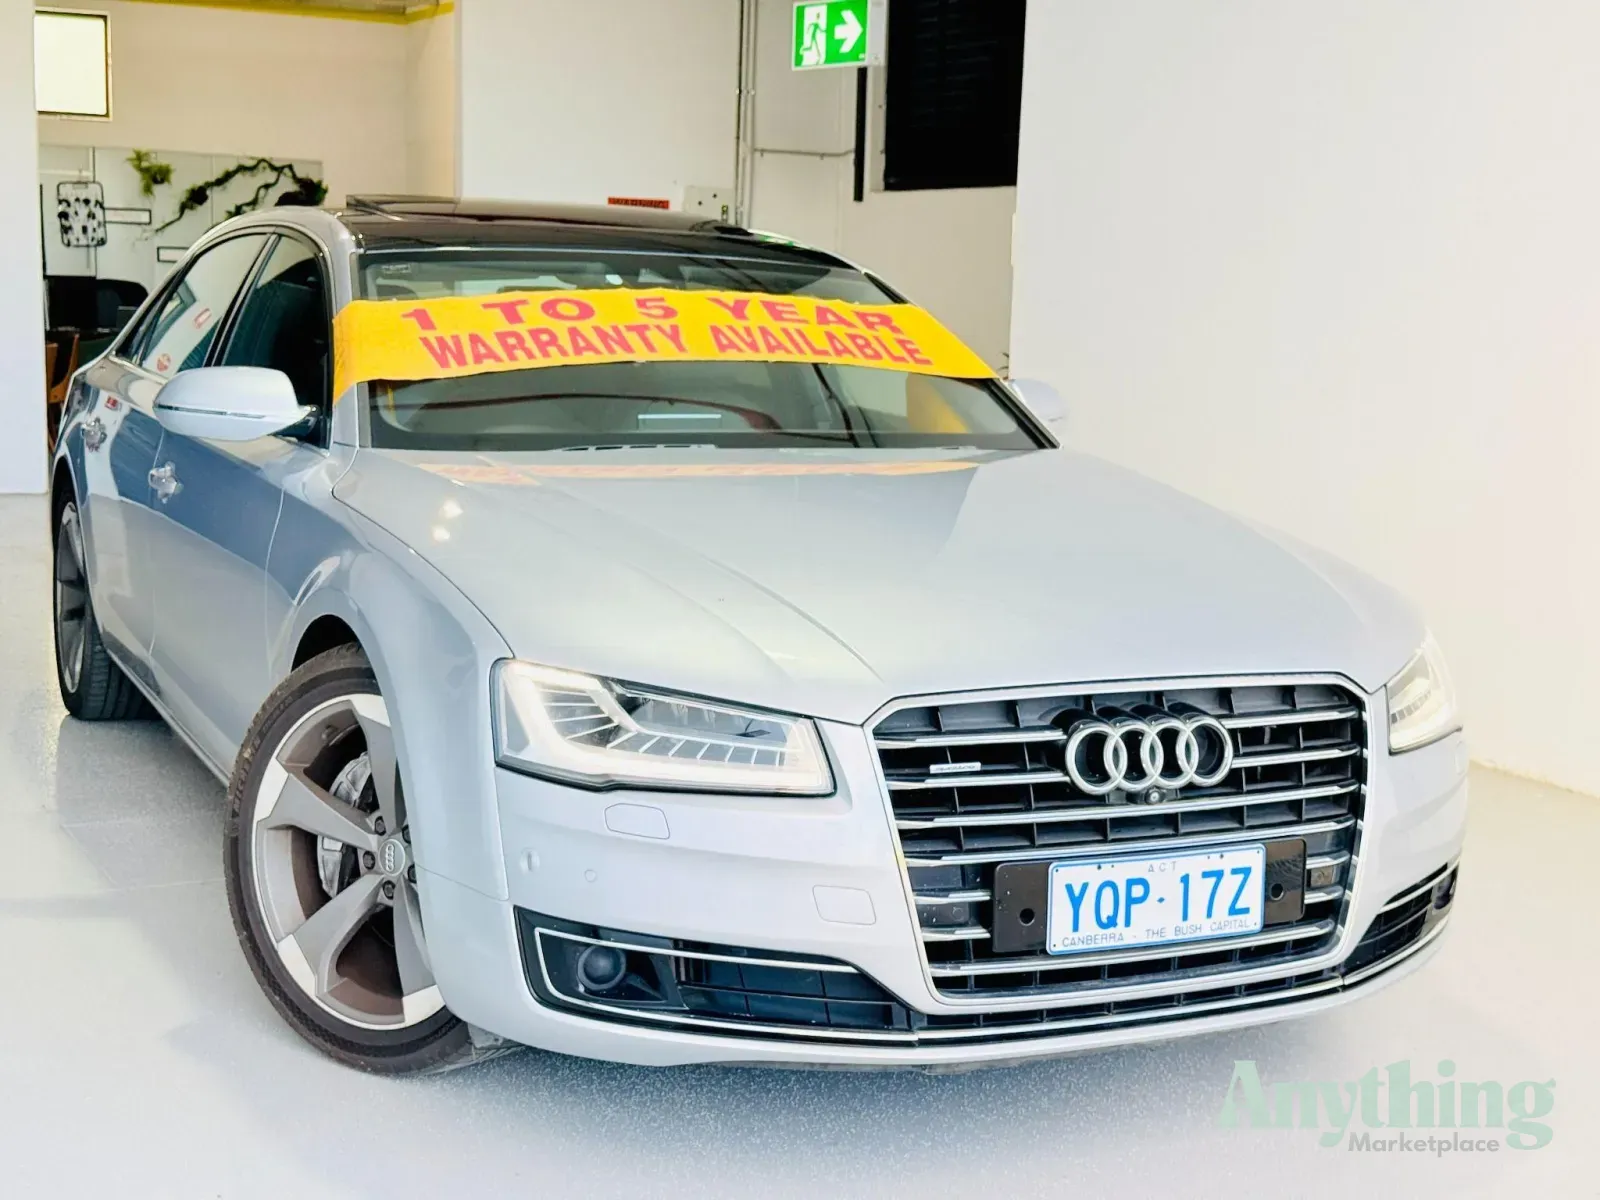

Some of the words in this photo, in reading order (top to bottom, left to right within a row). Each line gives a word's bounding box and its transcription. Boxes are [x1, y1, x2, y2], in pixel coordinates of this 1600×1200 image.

[401, 308, 437, 330] 1
[481, 298, 596, 325] TO
[635, 297, 679, 320] 5
[706, 297, 905, 335] YEAR
[419, 323, 689, 369] WARRANTY
[709, 324, 934, 366] AVAILABLE
[1147, 860, 1178, 873] ACT
[1061, 932, 1125, 948] CANBERRA
[1145, 928, 1167, 939] THE
[1174, 923, 1203, 936] BUSH
[1209, 918, 1250, 932] CAPITAL
